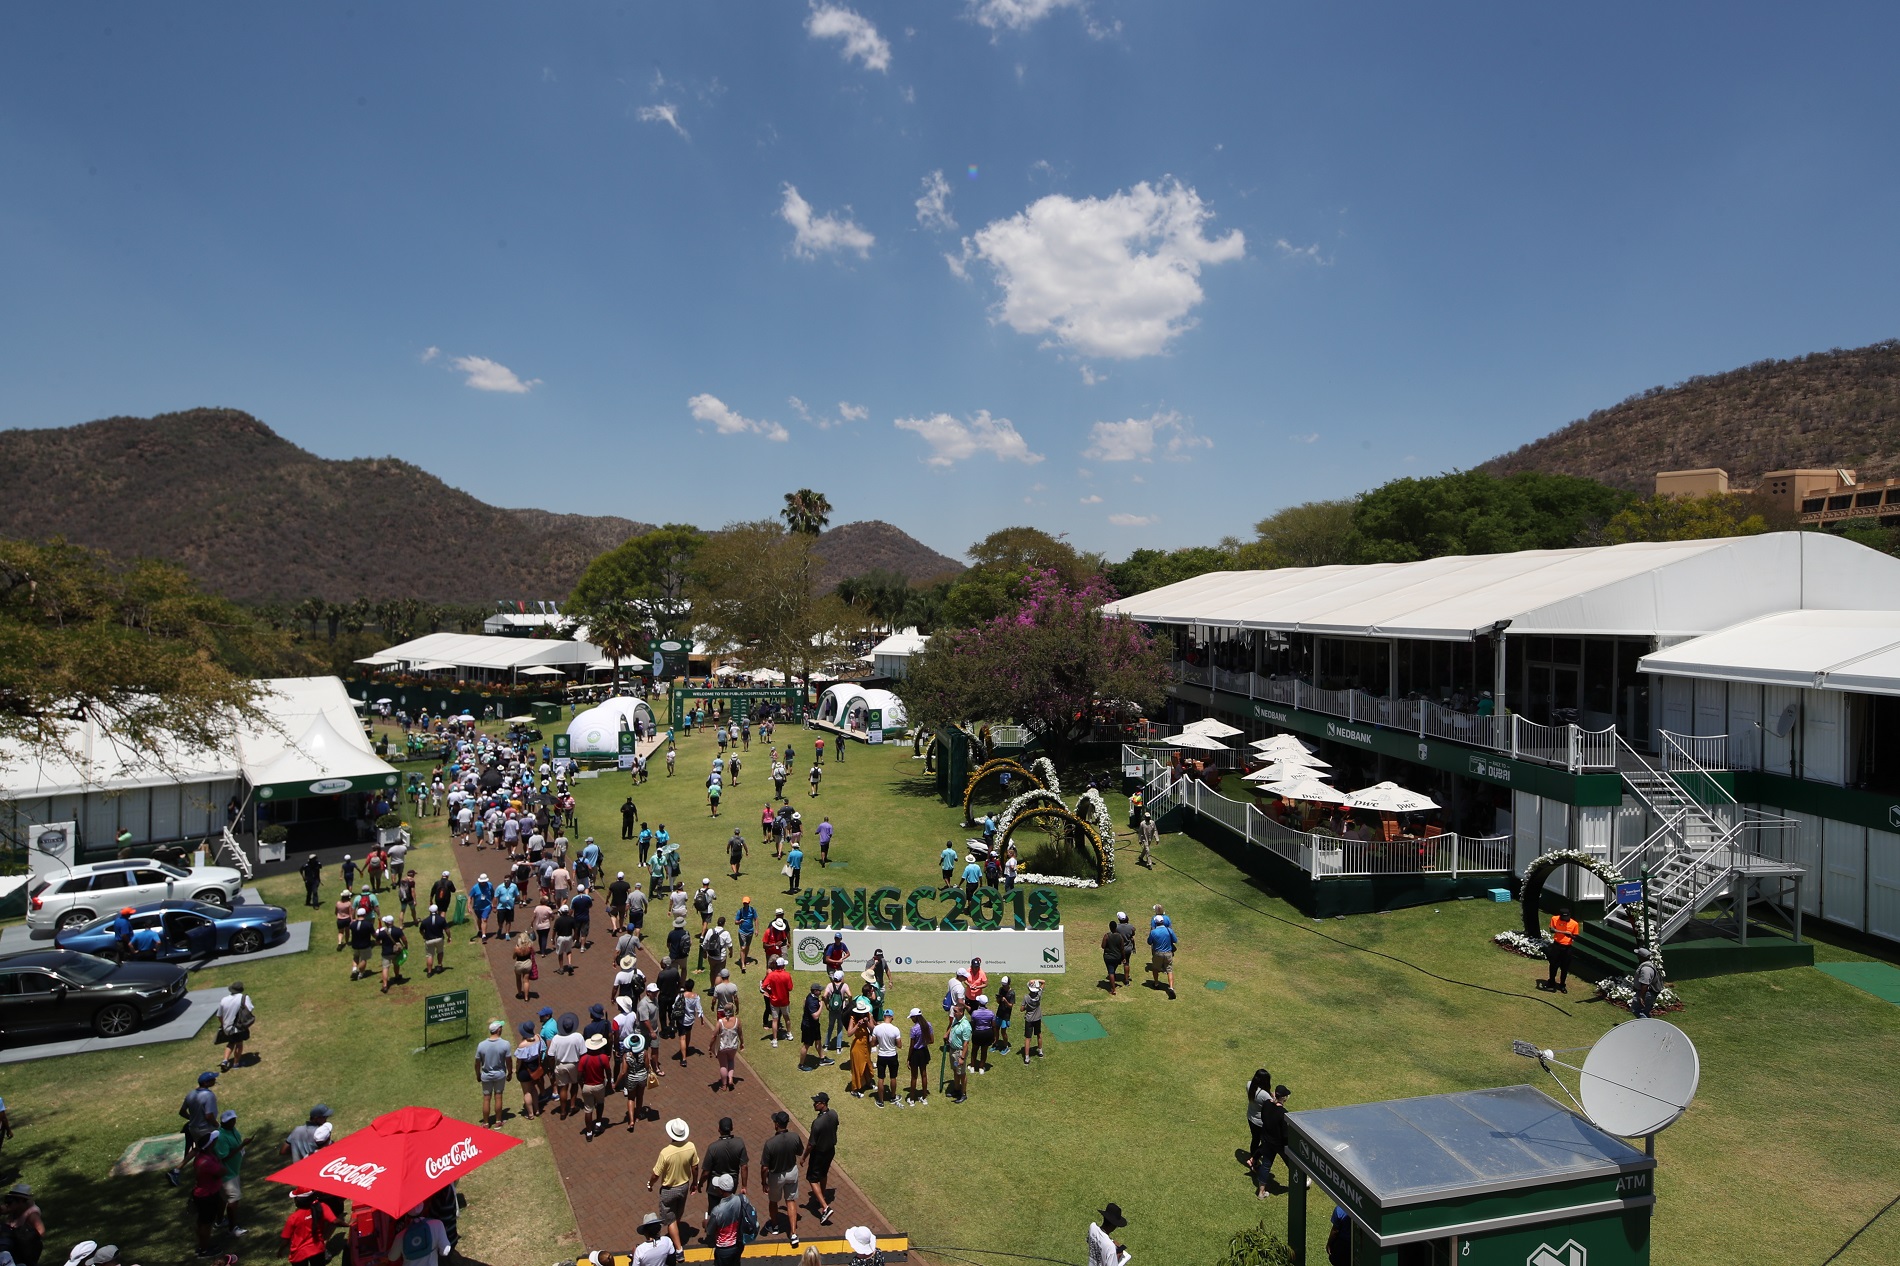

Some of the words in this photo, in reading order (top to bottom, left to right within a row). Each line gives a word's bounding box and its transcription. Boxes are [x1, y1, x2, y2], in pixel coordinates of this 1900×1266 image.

[1261, 708, 1287, 723] NEDBANK
[1336, 727, 1372, 744] NEDBANK
[1488, 765, 1511, 781] DUBAI
[1353, 800, 1379, 808] pwc
[1396, 802, 1418, 811] pwc
[794, 886, 1061, 931] #NGC2018
[799, 938, 823, 950] NEDBANK
[430, 1009, 463, 1019] GRANDSTAND
[425, 1137, 478, 1179] Coca-Cola
[319, 1156, 386, 1190] Coca-Cola
[1311, 1151, 1363, 1209] NEDBANK
[1615, 1174, 1646, 1192] ATM
